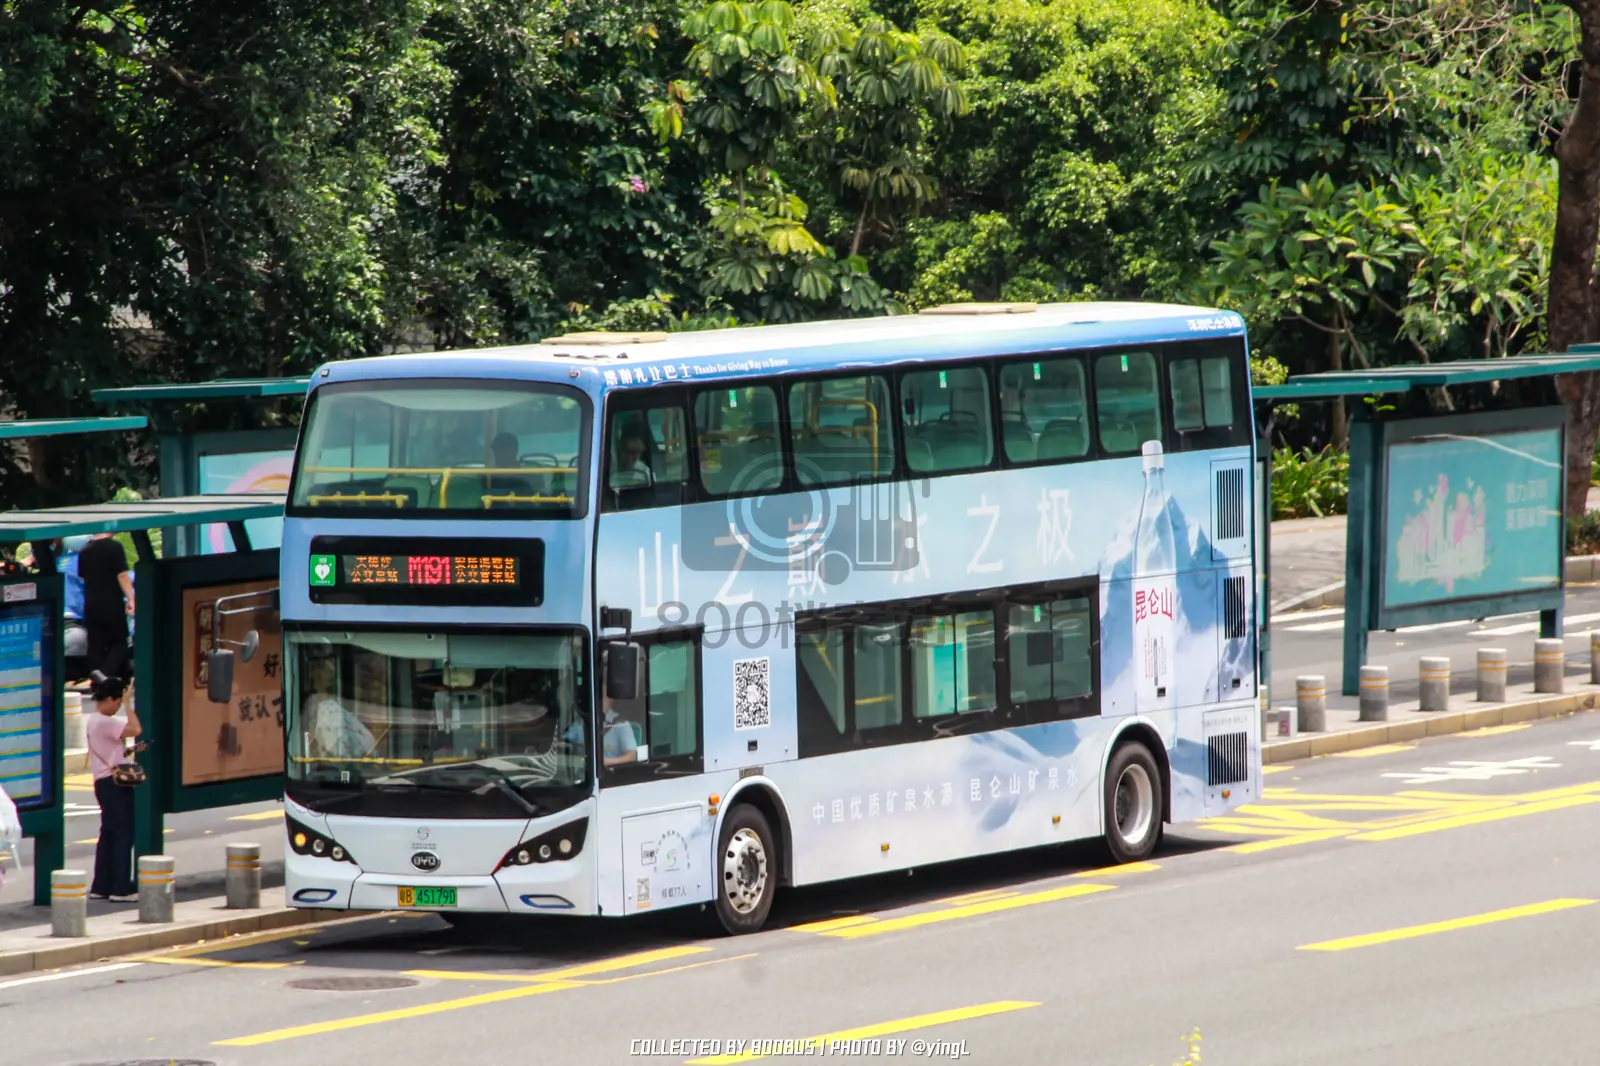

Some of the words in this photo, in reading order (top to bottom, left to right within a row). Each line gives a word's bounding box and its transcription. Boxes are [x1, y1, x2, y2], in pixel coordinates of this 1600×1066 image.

[693, 363, 717, 375] Thanks
[717, 363, 727, 373] for
[728, 361, 748, 372] Giving
[748, 359, 762, 370] Way
[407, 556, 451, 585] M191
[1135, 586, 1174, 626] 昆仑山
[812, 781, 954, 825] 中国优质矿泉水源
[970, 764, 1079, 802] 昆仑山矿泉水
[413, 856, 436, 866] BYD
